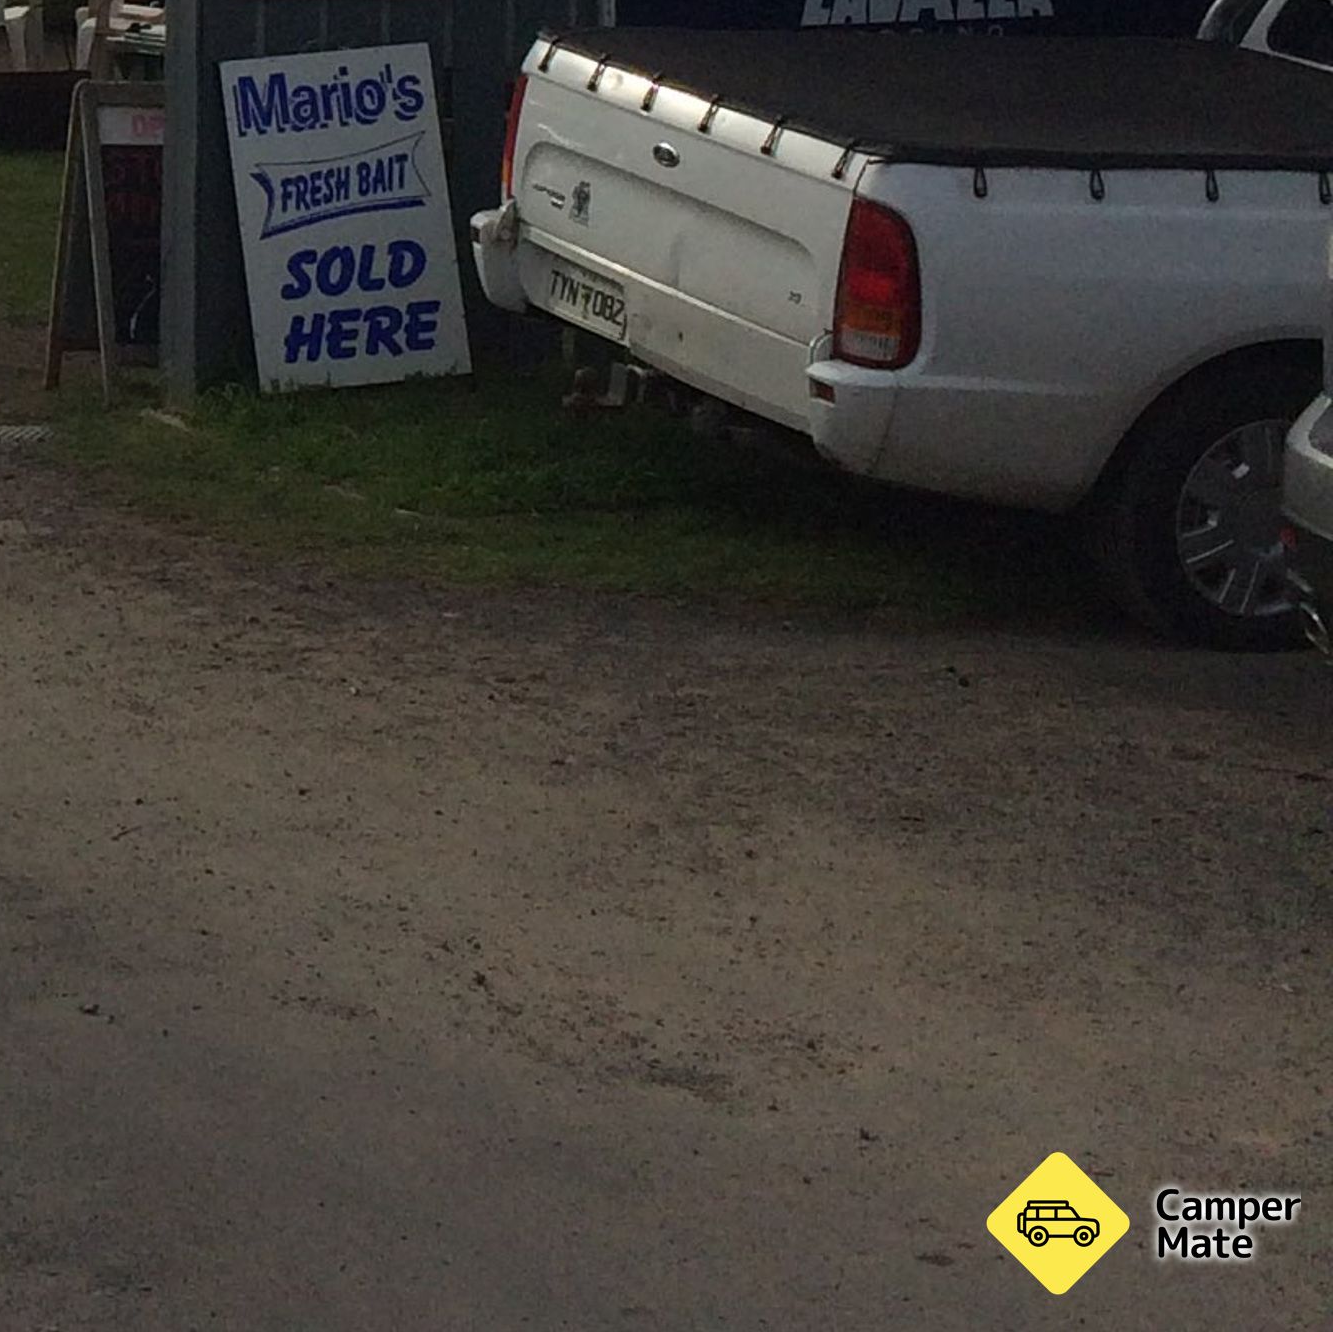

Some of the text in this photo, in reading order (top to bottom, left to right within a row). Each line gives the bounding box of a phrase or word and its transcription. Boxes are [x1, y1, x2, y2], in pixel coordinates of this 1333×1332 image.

[233, 63, 425, 137] Mario's
[280, 153, 409, 213] FRESH BAIT
[281, 240, 427, 300] SOLD
[550, 269, 581, 307] TYN
[591, 289, 626, 326] 082
[284, 300, 441, 363] HERE
